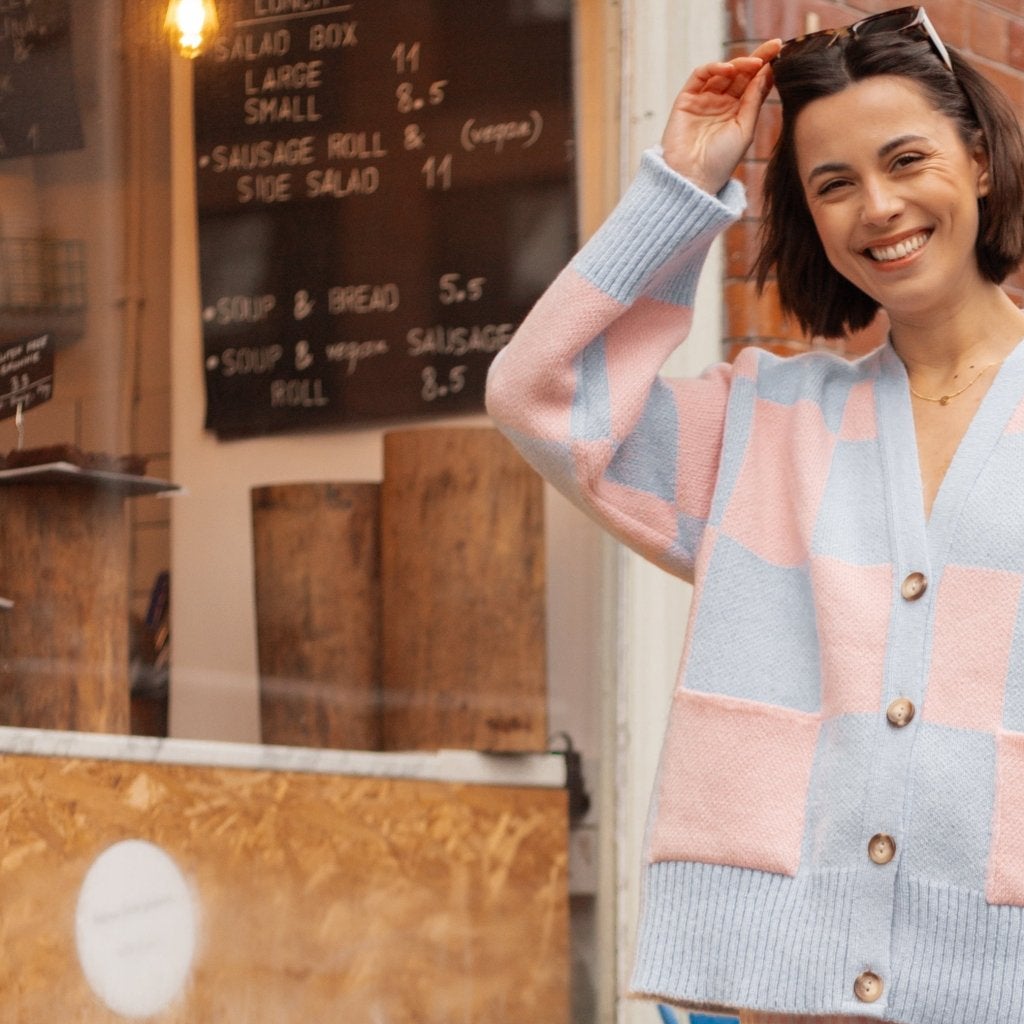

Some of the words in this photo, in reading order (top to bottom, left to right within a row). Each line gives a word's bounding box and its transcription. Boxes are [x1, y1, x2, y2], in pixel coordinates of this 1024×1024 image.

[212, 29, 291, 63] SALAD
[309, 21, 359, 52] BOX
[391, 41, 421, 74] 11
[244, 60, 323, 96] LARGE
[396, 79, 449, 114] 8.5
[244, 95, 322, 125] SMALL
[211, 136, 316, 173] SAUSAGE
[327, 131, 388, 160] ROLL
[236, 173, 293, 203] SIDE
[305, 166, 380, 198] SALAD
[421, 153, 453, 191] 11
[216, 294, 276, 325] SOUP
[293, 289, 316, 320] &
[328, 283, 400, 315] BREAD
[439, 272, 487, 304] 5.5
[220, 344, 283, 377] SOUP
[294, 340, 314, 371] &
[406, 323, 514, 357] SAUSAGE
[270, 378, 330, 408] ROLL
[421, 365, 467, 402] 8.5
